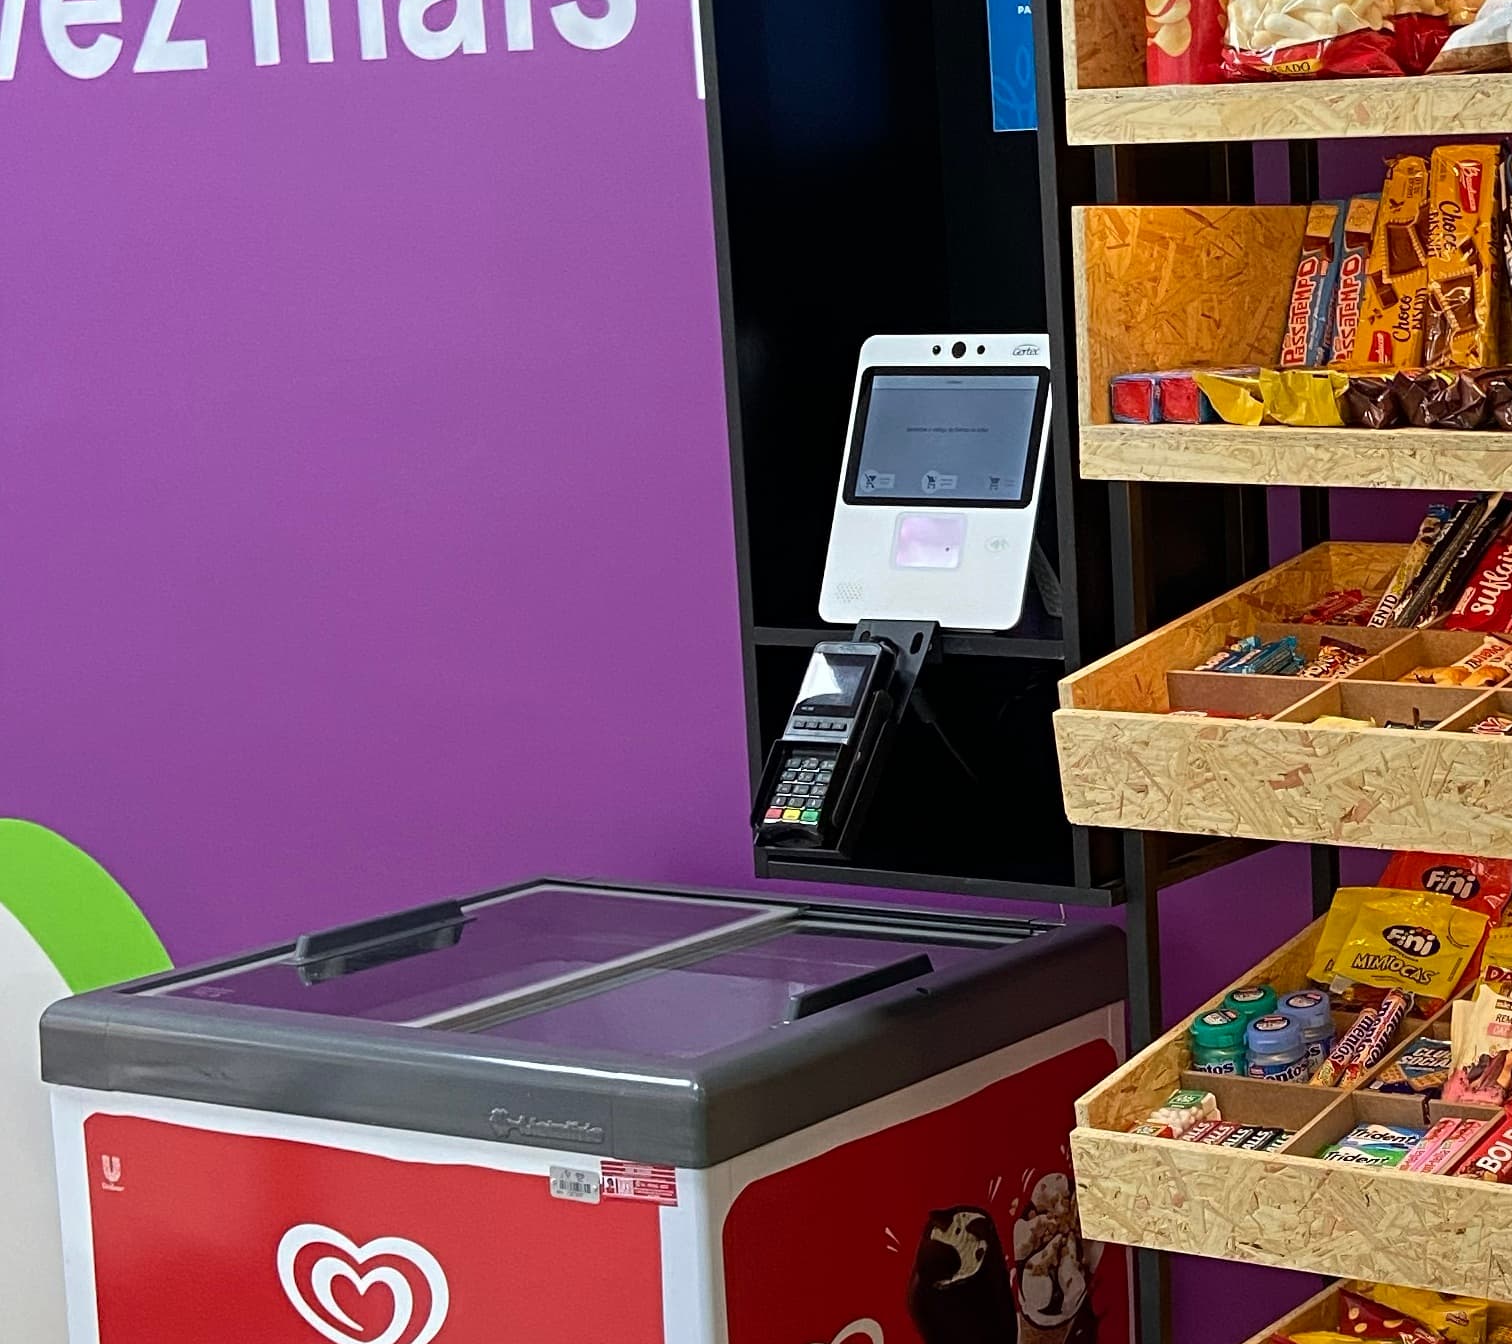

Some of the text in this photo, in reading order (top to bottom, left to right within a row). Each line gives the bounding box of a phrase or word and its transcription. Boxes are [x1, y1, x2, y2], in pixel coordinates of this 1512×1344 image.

[1426, 867, 1477, 900] Fini
[1386, 926, 1439, 956] Fini
[1181, 1121, 1211, 1142] ALLS
[1203, 1124, 1231, 1145] ALLS
[1222, 1128, 1249, 1147] ALLS
[1241, 1130, 1270, 1150] ALLS
[1350, 1128, 1419, 1146] Trident
[1266, 1133, 1292, 1153] ALLS
